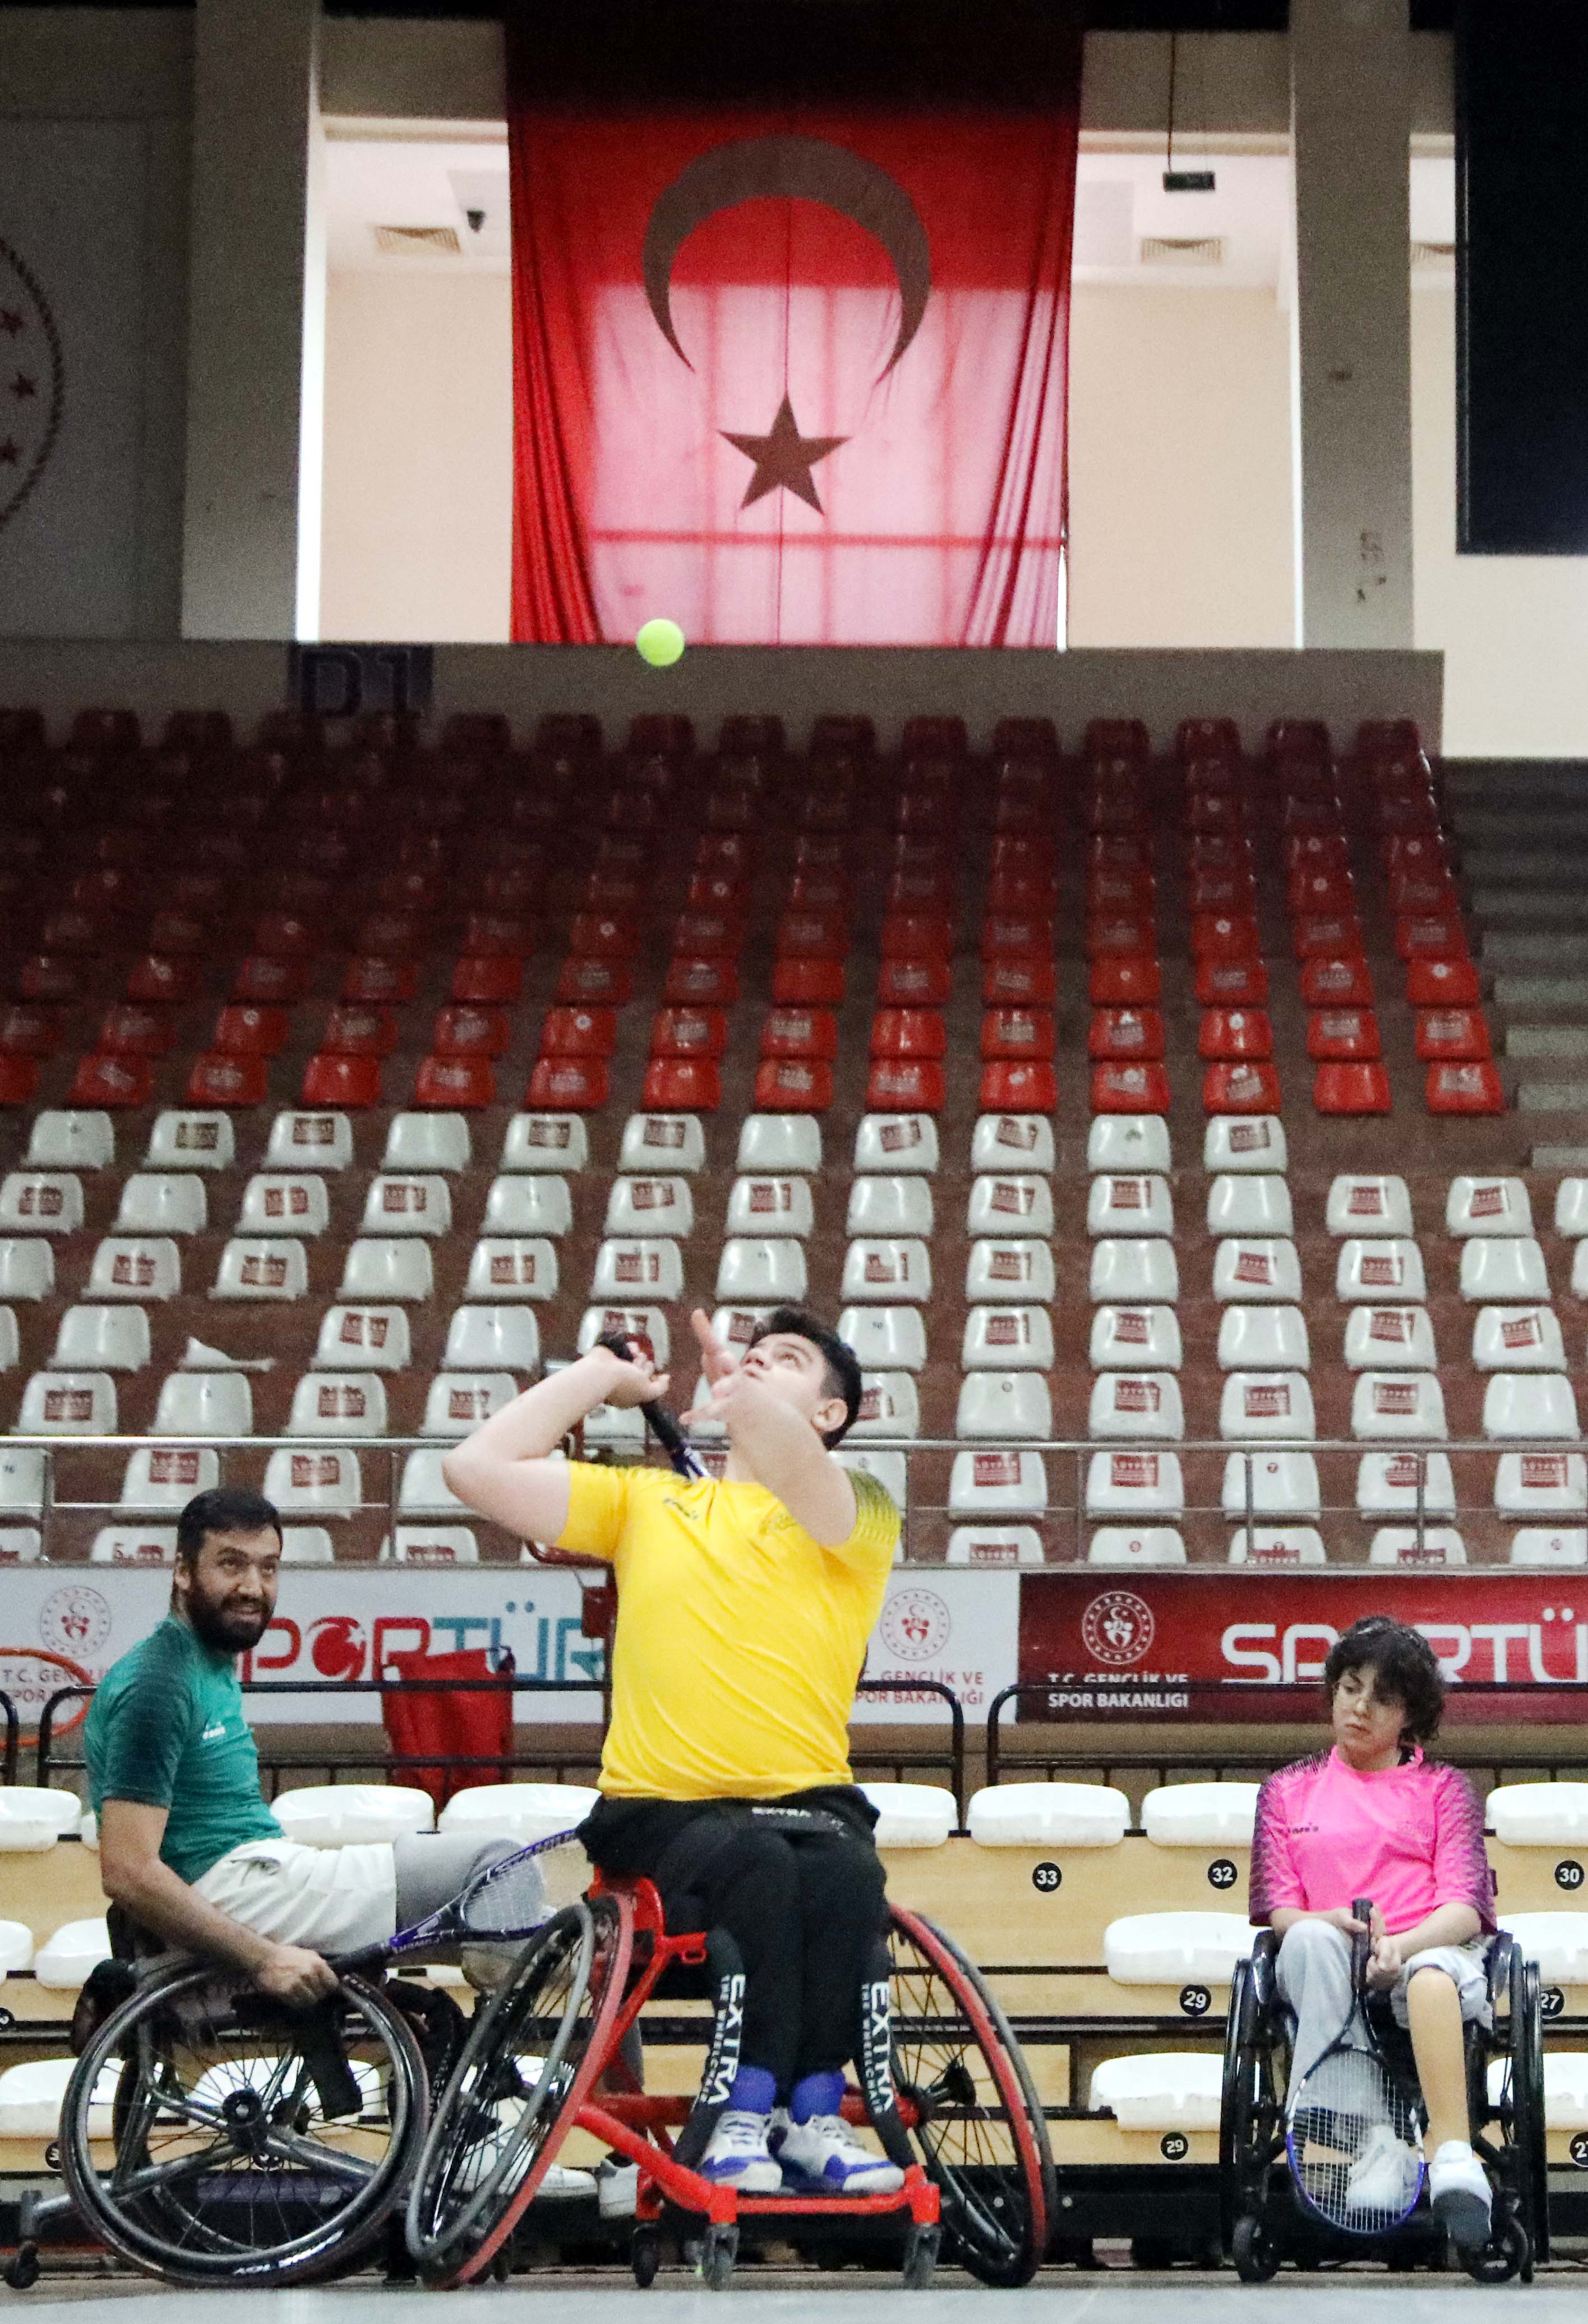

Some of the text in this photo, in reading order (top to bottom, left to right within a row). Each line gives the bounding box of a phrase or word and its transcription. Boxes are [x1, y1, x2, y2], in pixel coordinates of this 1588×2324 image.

[302, 649, 416, 718] D1
[1221, 1608, 1588, 1684] SPRTÜ
[962, 1672, 983, 1684] VE
[855, 1690, 888, 1703] POR
[1048, 1693, 1093, 1707] SPOR
[1036, 1869, 1058, 1885] 33
[1212, 1866, 1234, 1883] 32
[1559, 1868, 1580, 1883] 30
[1183, 1990, 1207, 2009] 29
[1540, 1992, 1561, 2010] 27
[708, 1974, 746, 2105] EXTRA
[871, 1981, 894, 2112] EXTRA
[1166, 2138, 1184, 2154] 29
[1574, 2141, 1588, 2159] 2
